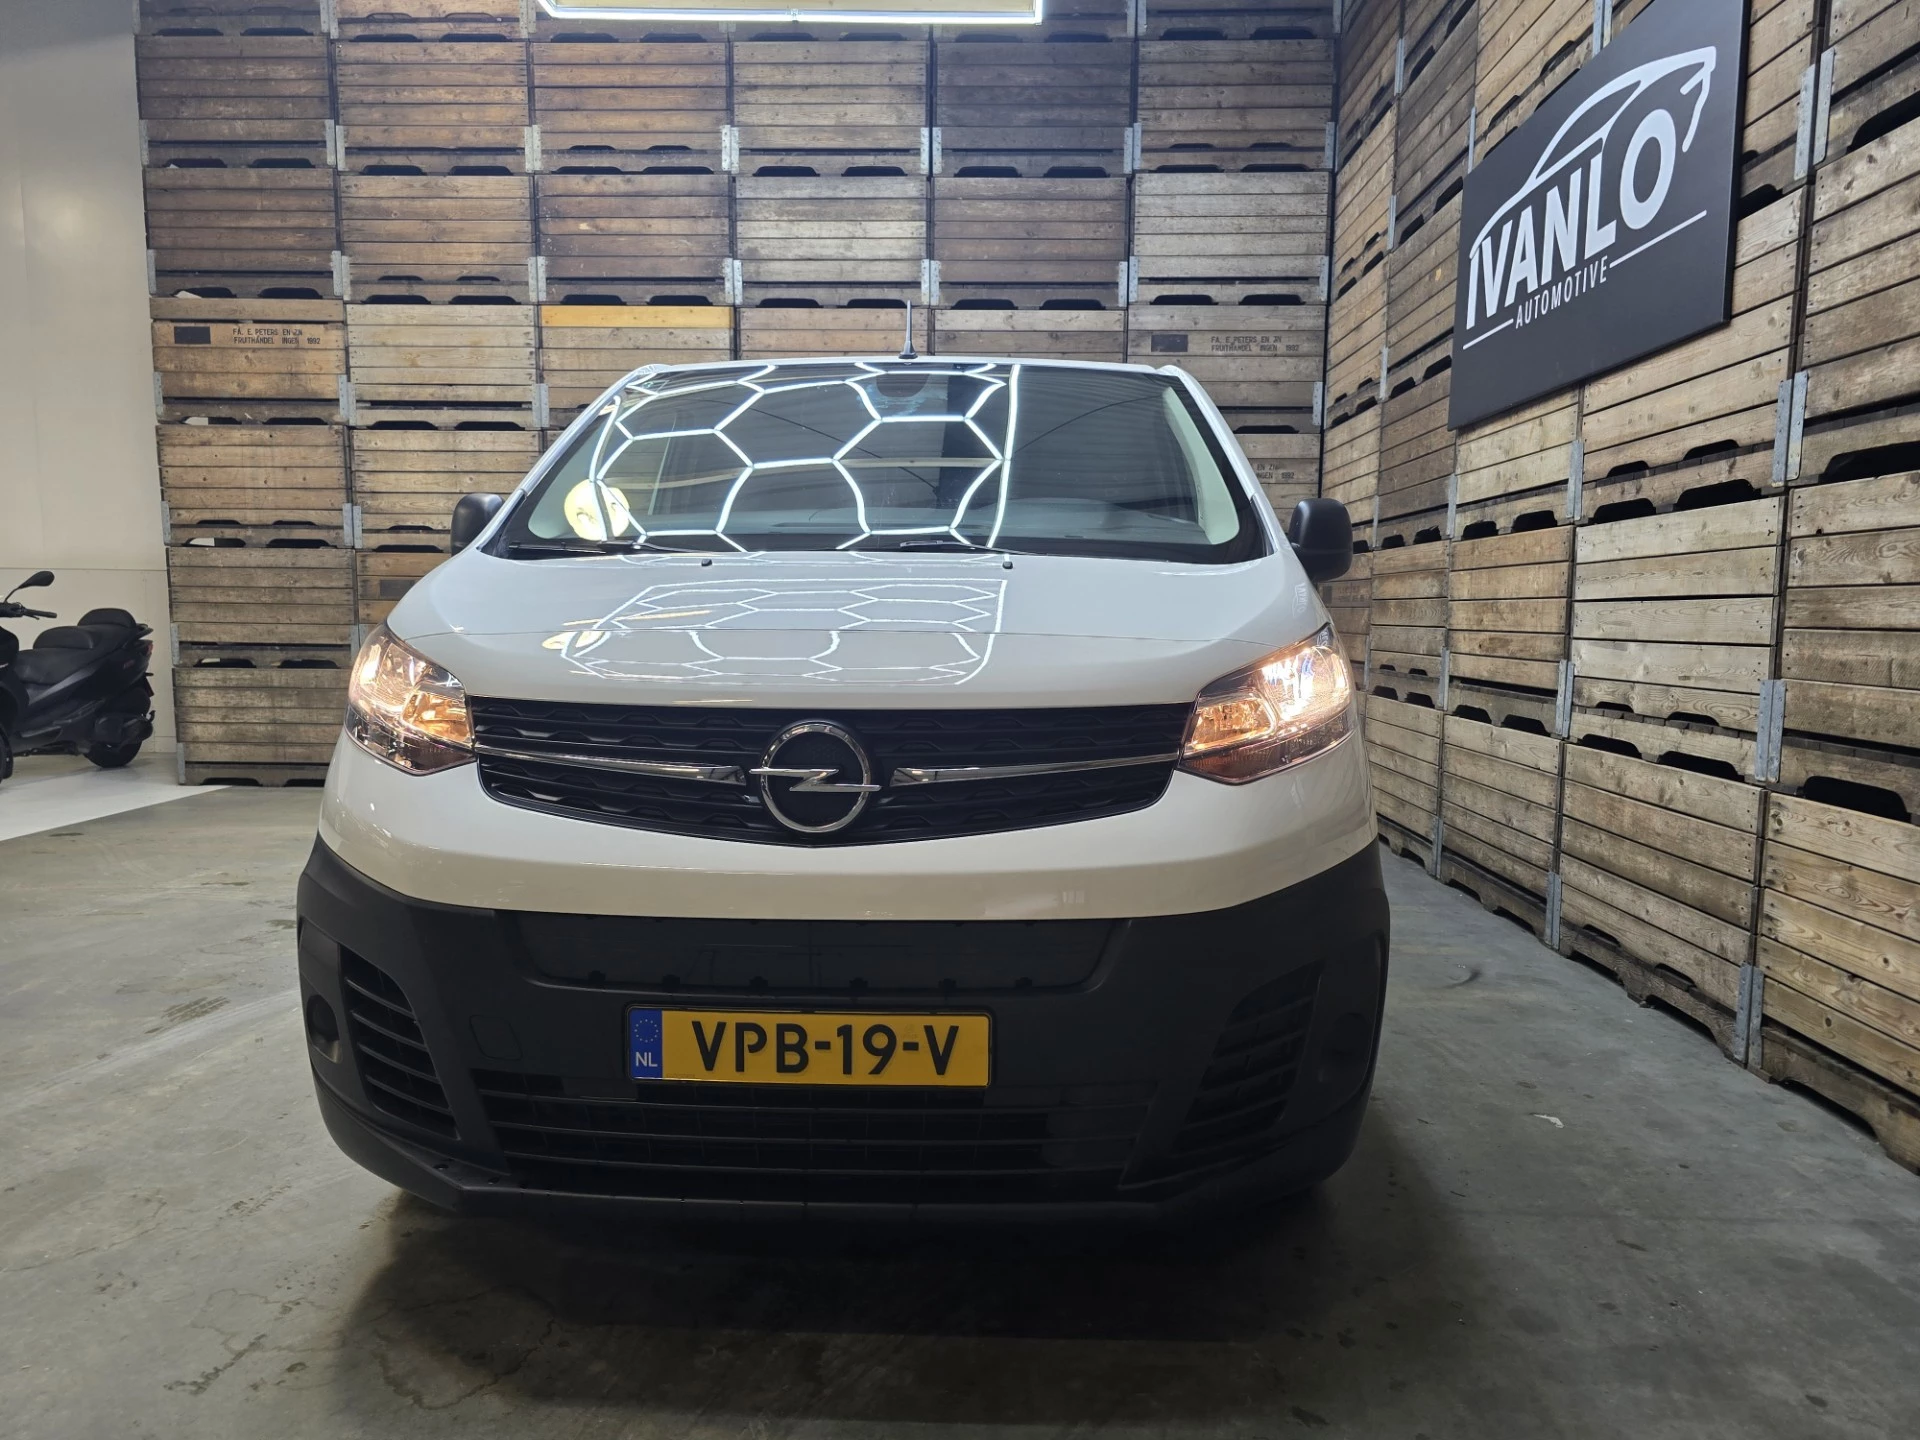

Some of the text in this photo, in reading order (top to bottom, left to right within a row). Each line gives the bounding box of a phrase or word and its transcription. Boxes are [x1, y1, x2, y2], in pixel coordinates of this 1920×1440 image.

[1515, 255, 1609, 329] AUTOMOTIVE
[255, 328, 278, 336] PETERS
[282, 328, 291, 336] EN
[1233, 336, 1257, 344] PETERS
[691, 1020, 959, 1076] VPB-19-V
[635, 1052, 658, 1068] NL
